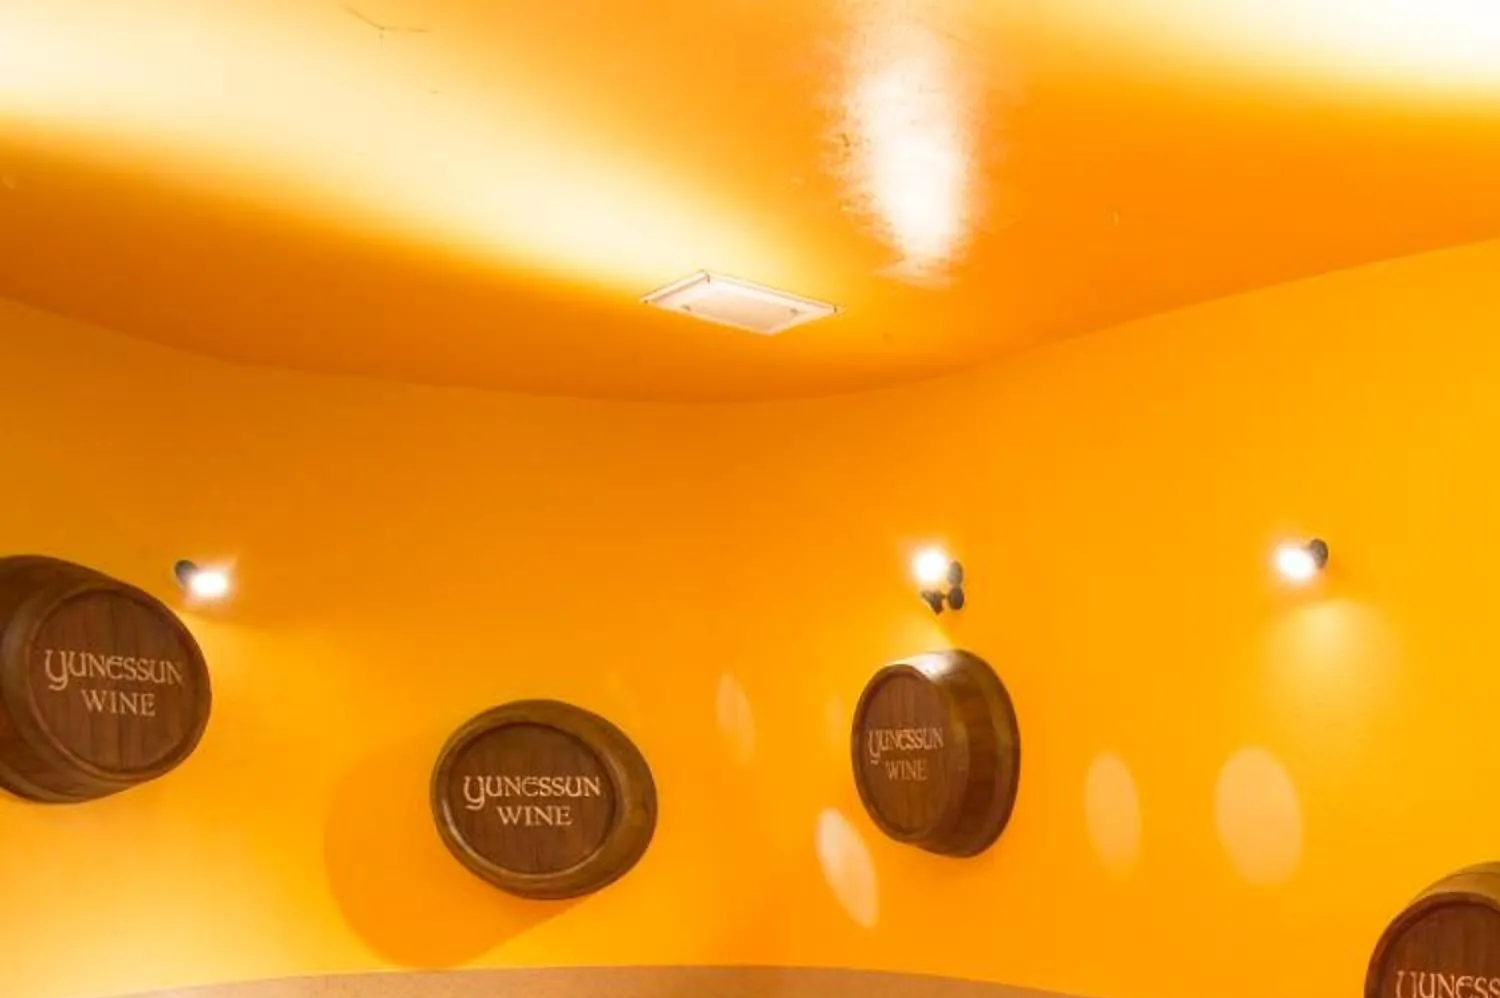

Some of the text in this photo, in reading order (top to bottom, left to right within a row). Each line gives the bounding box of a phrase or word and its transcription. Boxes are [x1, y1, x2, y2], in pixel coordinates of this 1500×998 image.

[44, 649, 184, 692] YUNESSUN
[80, 688, 157, 717] WINE
[868, 727, 944, 765] YUNESSUN
[885, 760, 928, 781] WINE
[463, 775, 601, 811] YUNESSUN
[495, 805, 575, 827] WINE
